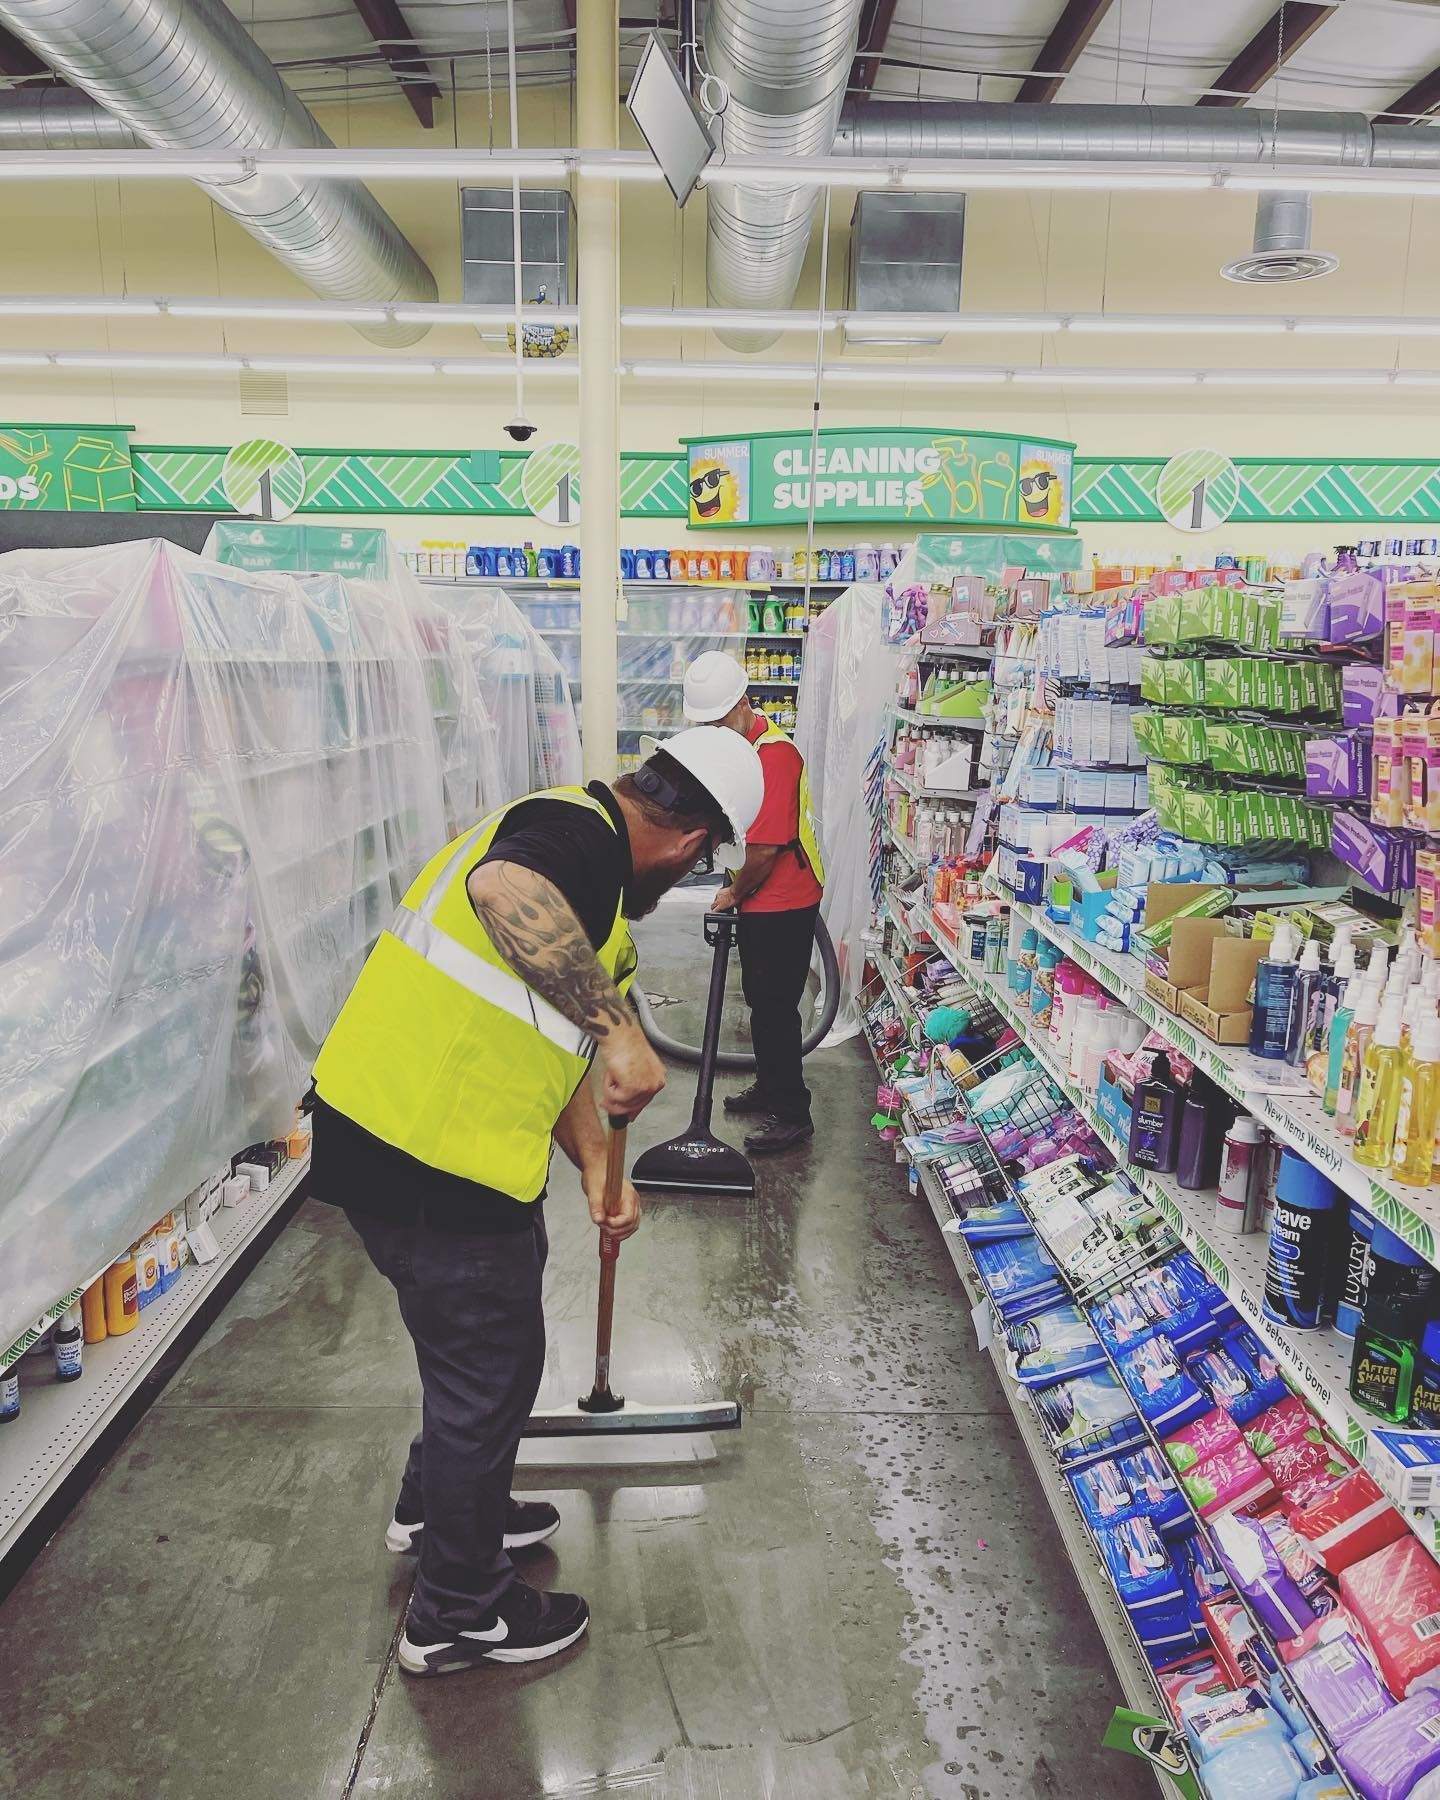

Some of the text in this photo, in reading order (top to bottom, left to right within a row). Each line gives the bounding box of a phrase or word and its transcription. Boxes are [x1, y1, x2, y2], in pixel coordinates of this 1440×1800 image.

[704, 446, 749, 460] SUMMER
[1036, 450, 1072, 465] SUMMER
[773, 447, 941, 476] CLEANING
[773, 478, 924, 509] SUPPLIES
[250, 529, 265, 545] 6
[340, 533, 353, 548] 5
[950, 541, 963, 556] 5
[333, 560, 363, 571] BABY
[1137, 1115, 1164, 1128] slumber
[1264, 1099, 1343, 1172] New Items Weekly!
[667, 1145, 727, 1153] EVOLUTION
[1276, 1205, 1311, 1231] have
[1275, 1224, 1300, 1242] ream
[1345, 1232, 1366, 1304] LUXURY
[1240, 1289, 1259, 1317] Grab
[1265, 1322, 1291, 1356] Before
[1292, 1349, 1304, 1372] It's
[1304, 1366, 1331, 1405] Gone!
[1358, 1358, 1397, 1376] AFTER
[1356, 1371, 1396, 1384] SHAVE
[1412, 1397, 1440, 1412] SHAV
